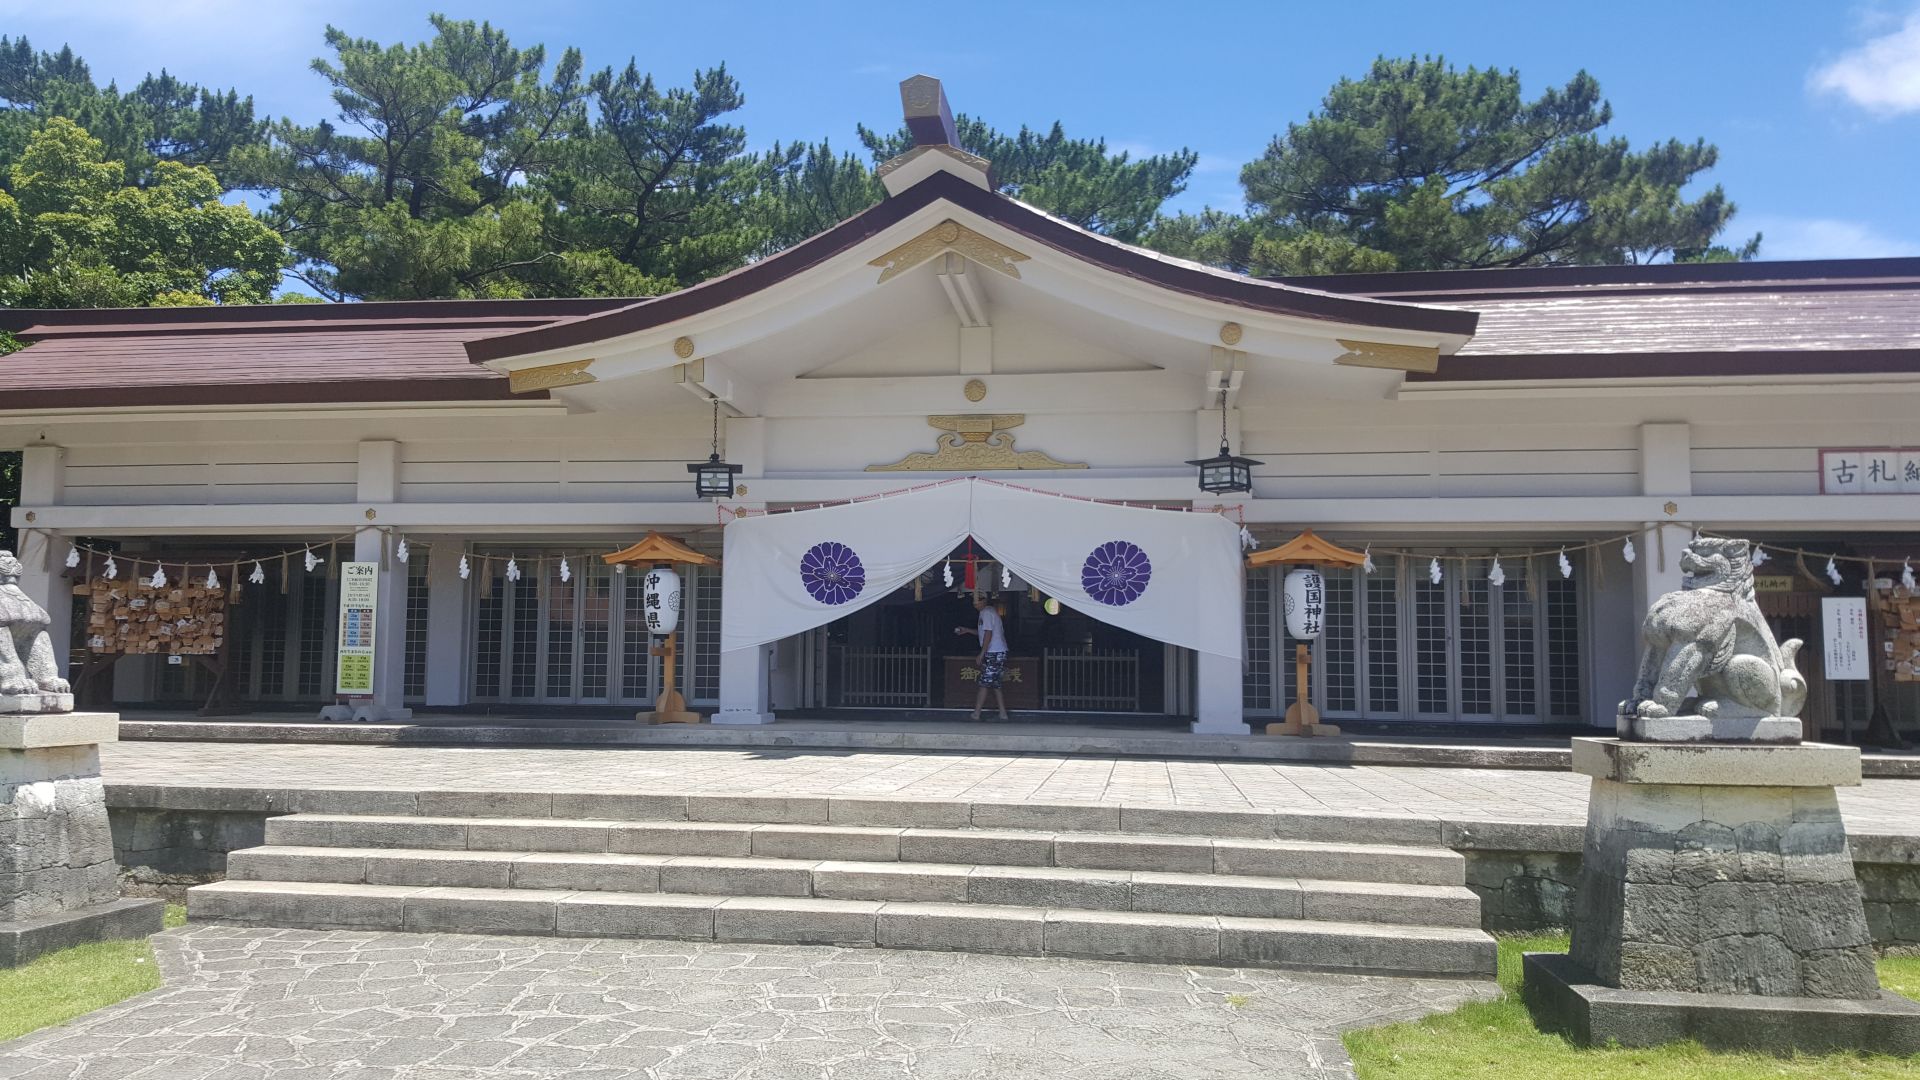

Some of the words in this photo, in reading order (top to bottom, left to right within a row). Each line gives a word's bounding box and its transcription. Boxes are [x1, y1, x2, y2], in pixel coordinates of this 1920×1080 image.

[347, 565, 373, 576] ご案内
[646, 573, 661, 629] 沖縄県
[1303, 574, 1322, 635] 護国神社
